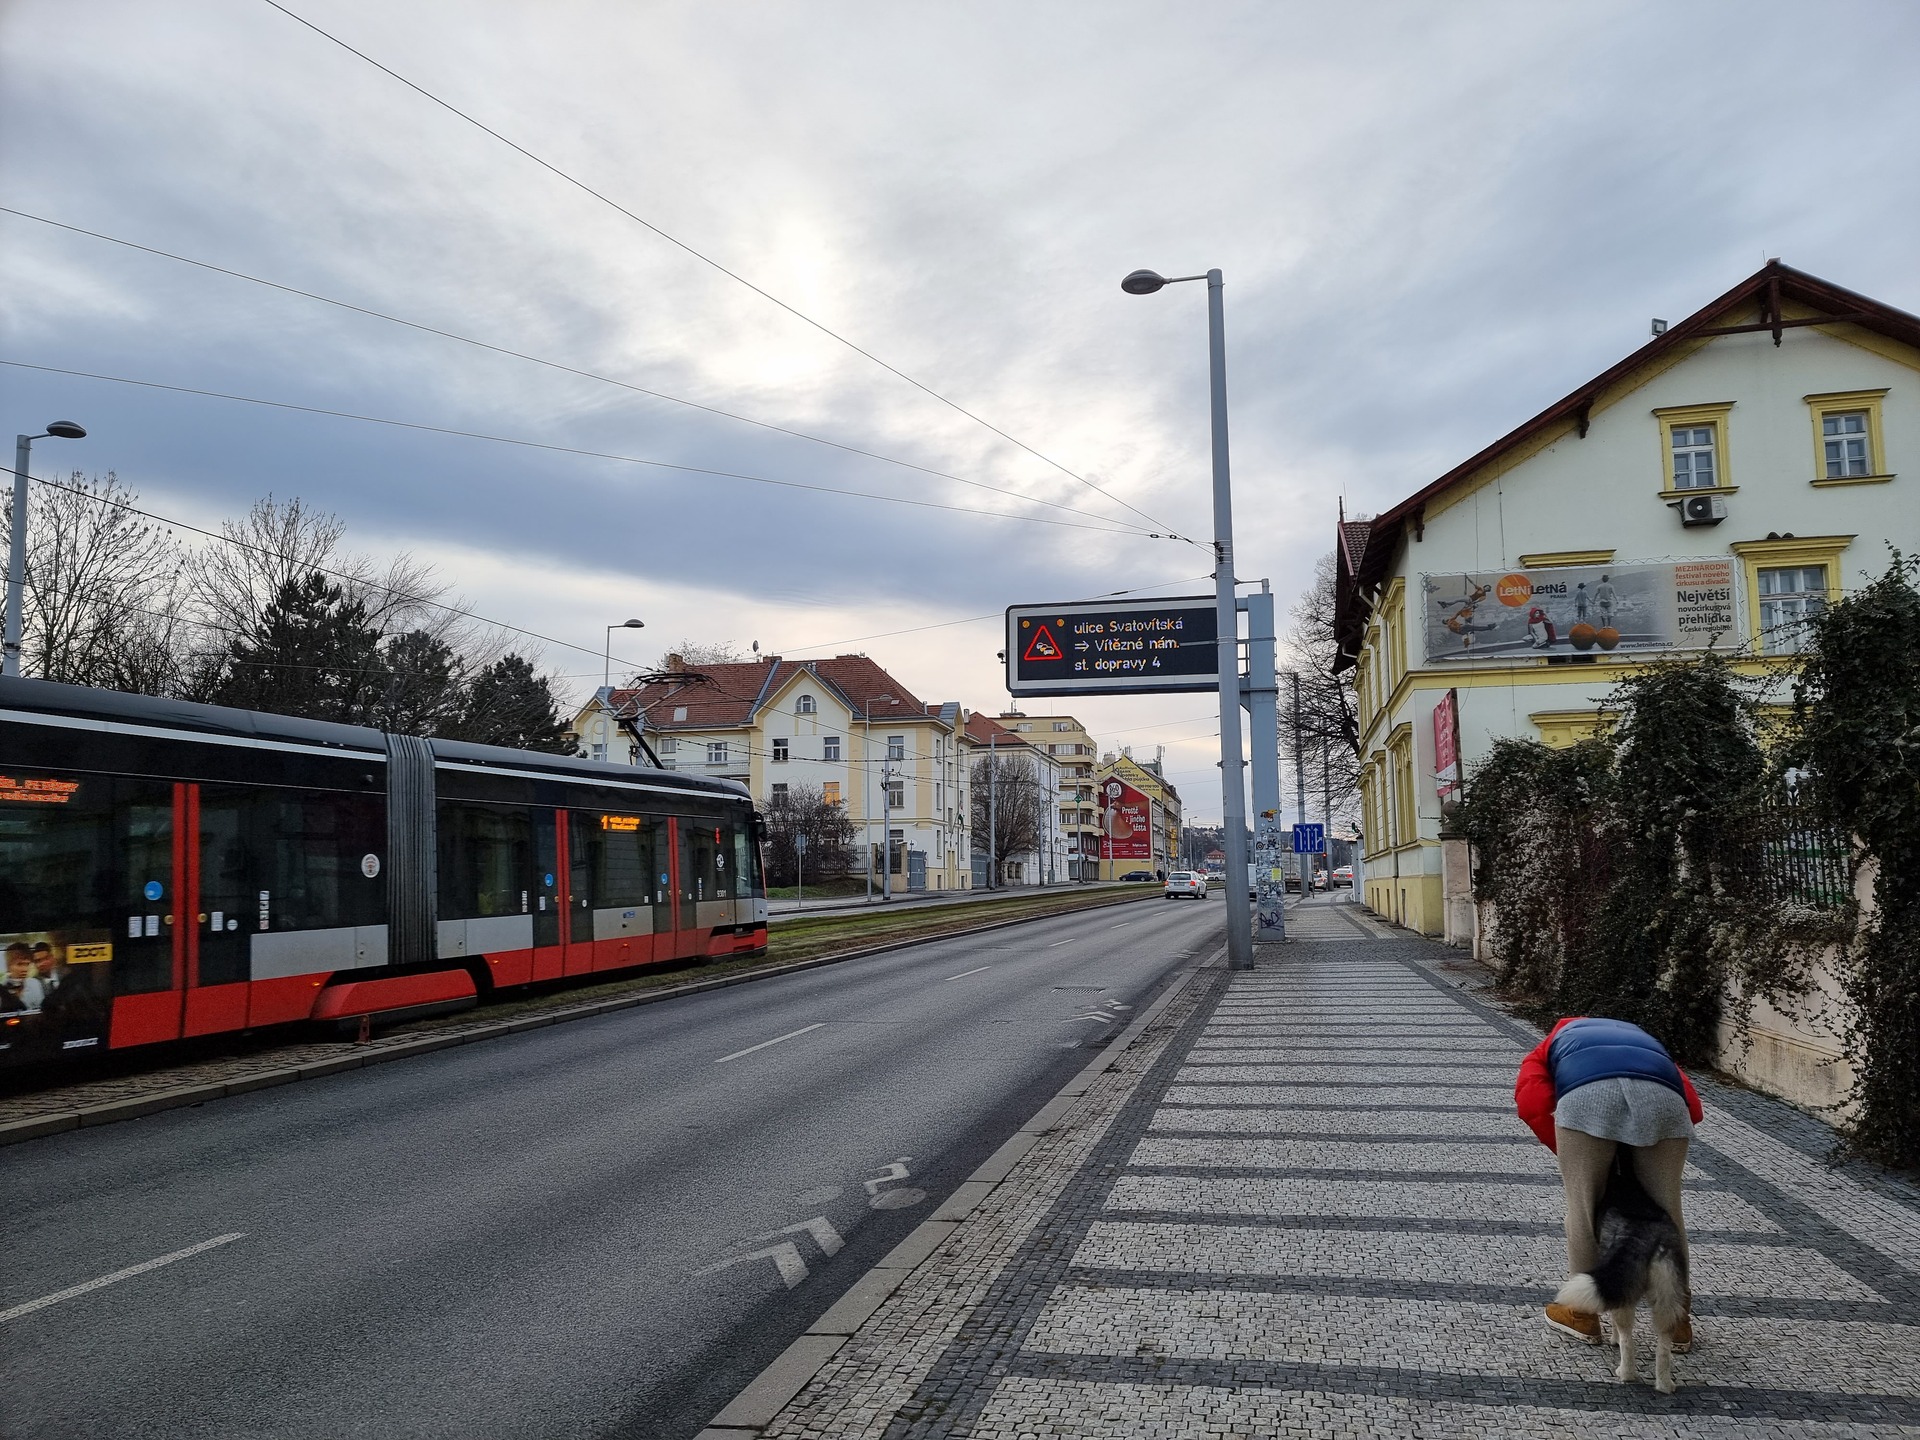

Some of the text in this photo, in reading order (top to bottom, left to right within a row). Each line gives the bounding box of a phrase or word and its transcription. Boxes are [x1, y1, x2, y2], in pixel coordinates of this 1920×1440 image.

[1677, 588, 1730, 605] Největší
[1074, 617, 1183, 635] ulice Svatovítská
[1678, 613, 1732, 627] přehlídka
[1095, 636, 1180, 652] Vítězné nám.
[1074, 656, 1161, 672] st. dopravy 4
[601, 815, 608, 830] 1
